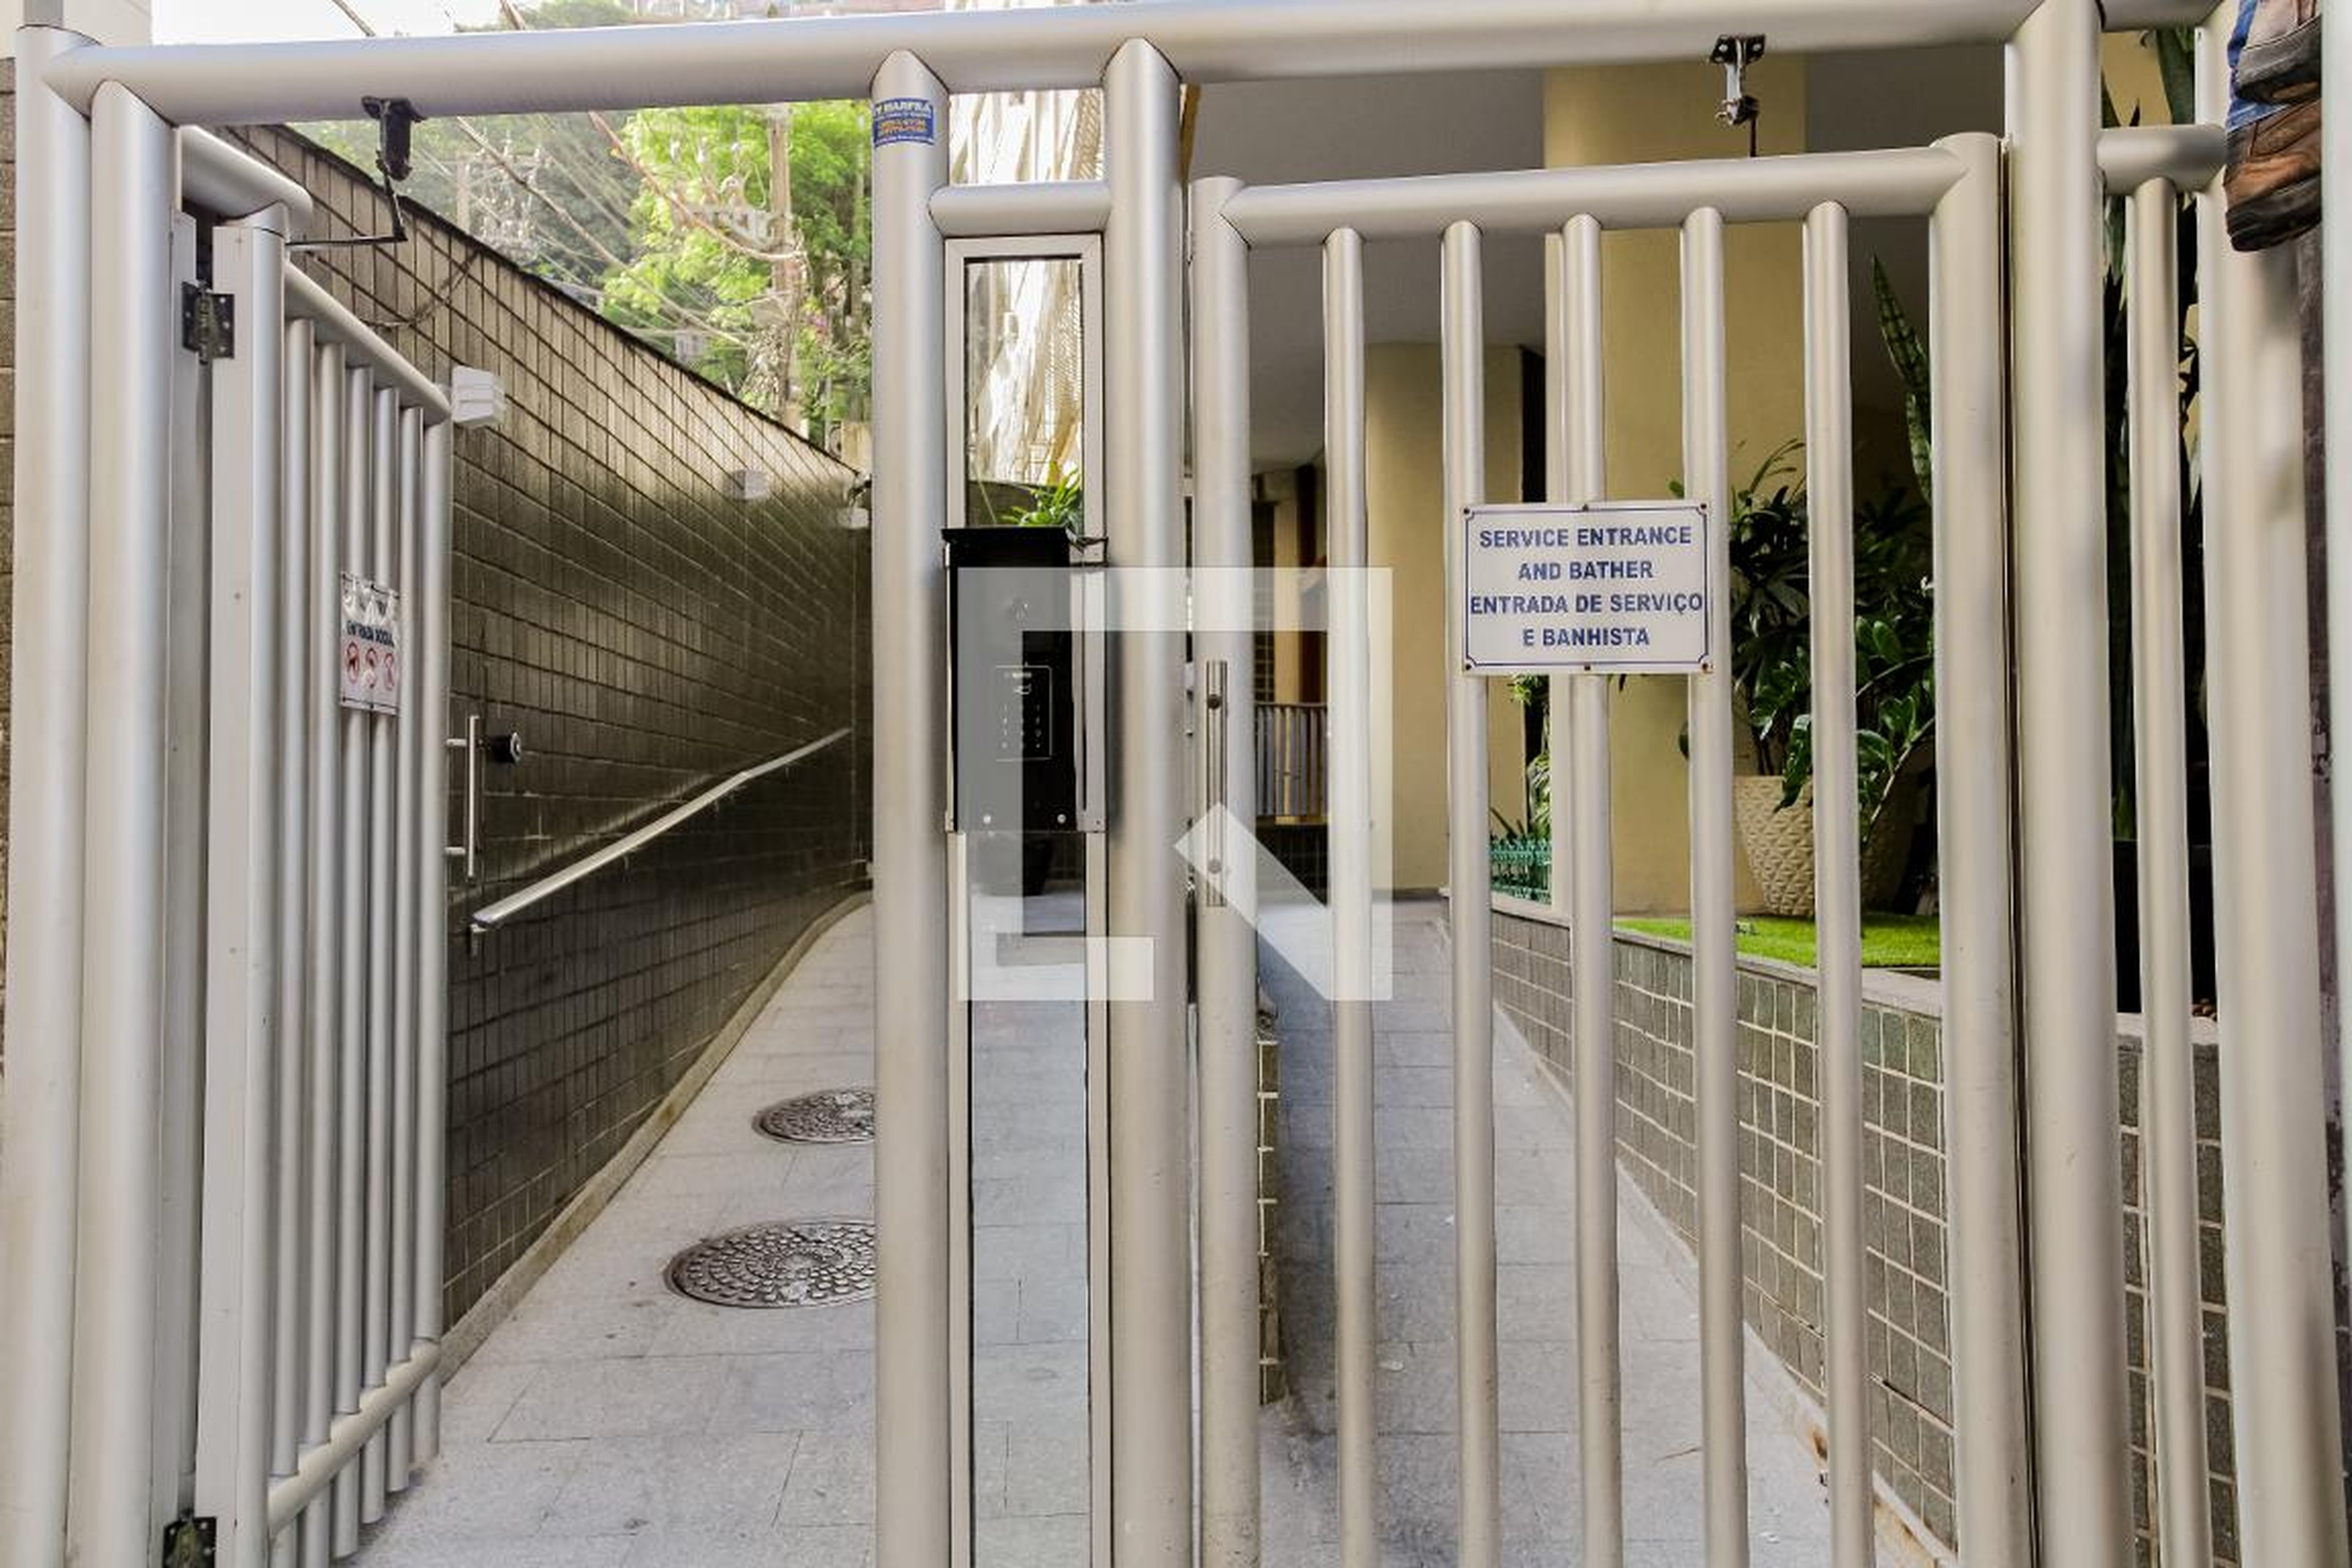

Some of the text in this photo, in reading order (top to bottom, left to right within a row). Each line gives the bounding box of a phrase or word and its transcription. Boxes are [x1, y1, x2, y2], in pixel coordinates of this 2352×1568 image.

[1479, 526, 1692, 549] SERVICE ENTRANCE
[1518, 560, 1654, 581] AND BATHER
[1470, 592, 1703, 616] ENTRADA DE SERVIÇO
[1523, 627, 1650, 647] E BANHISTA
